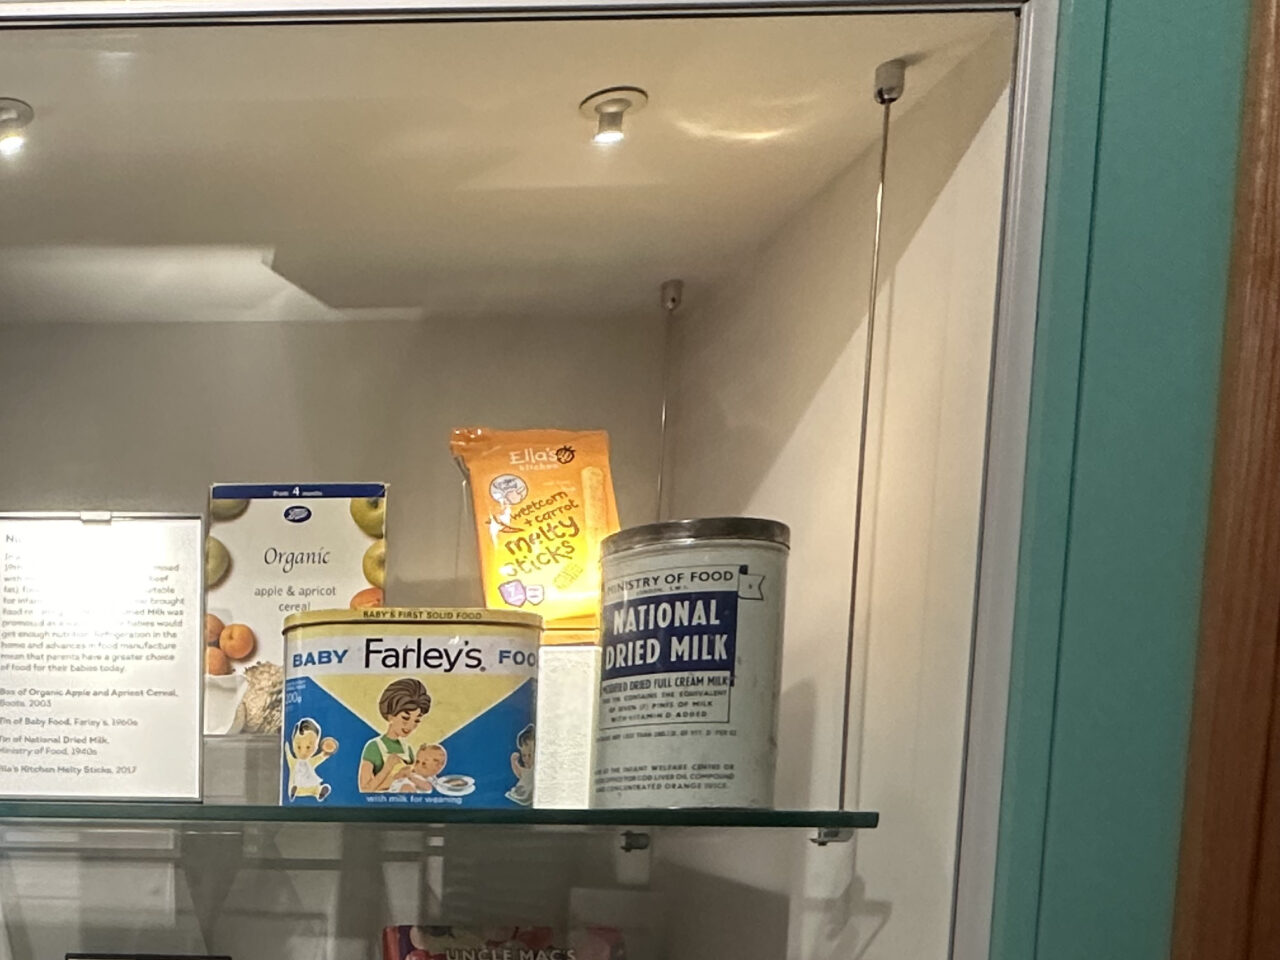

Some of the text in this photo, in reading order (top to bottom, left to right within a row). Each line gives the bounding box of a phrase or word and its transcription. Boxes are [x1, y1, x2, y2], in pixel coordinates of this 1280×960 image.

[509, 448, 558, 465] Ella's
[292, 486, 300, 496] 4
[506, 491, 569, 521] weetcorn
[535, 501, 580, 524] carrot
[504, 516, 580, 556] melty
[264, 547, 331, 574] Organic
[606, 570, 734, 595] MINISTRY OF FOOD
[254, 586, 336, 598] apple & apricot
[148, 608, 165, 616] Milk
[278, 602, 310, 612] cereal
[363, 611, 482, 620] BABY'S FIRST SOLID FOOD
[613, 599, 720, 636] NATIONAL
[292, 650, 348, 668] BABY
[364, 638, 483, 672] Farley's
[606, 634, 728, 670] DRIED MILK
[629, 676, 728, 690] DRIED FULL CREAM MILK
[28, 688, 63, 698] Organic
[65, 689, 90, 698] Apple
[111, 688, 144, 698] Apricot
[24, 718, 46, 728] Baby
[48, 718, 72, 726] Food,
[24, 736, 61, 744] National
[63, 736, 87, 744] Dried
[20, 766, 55, 774] Kitchen
[58, 766, 82, 776] Melty
[366, 794, 463, 805] with milk for weaning
